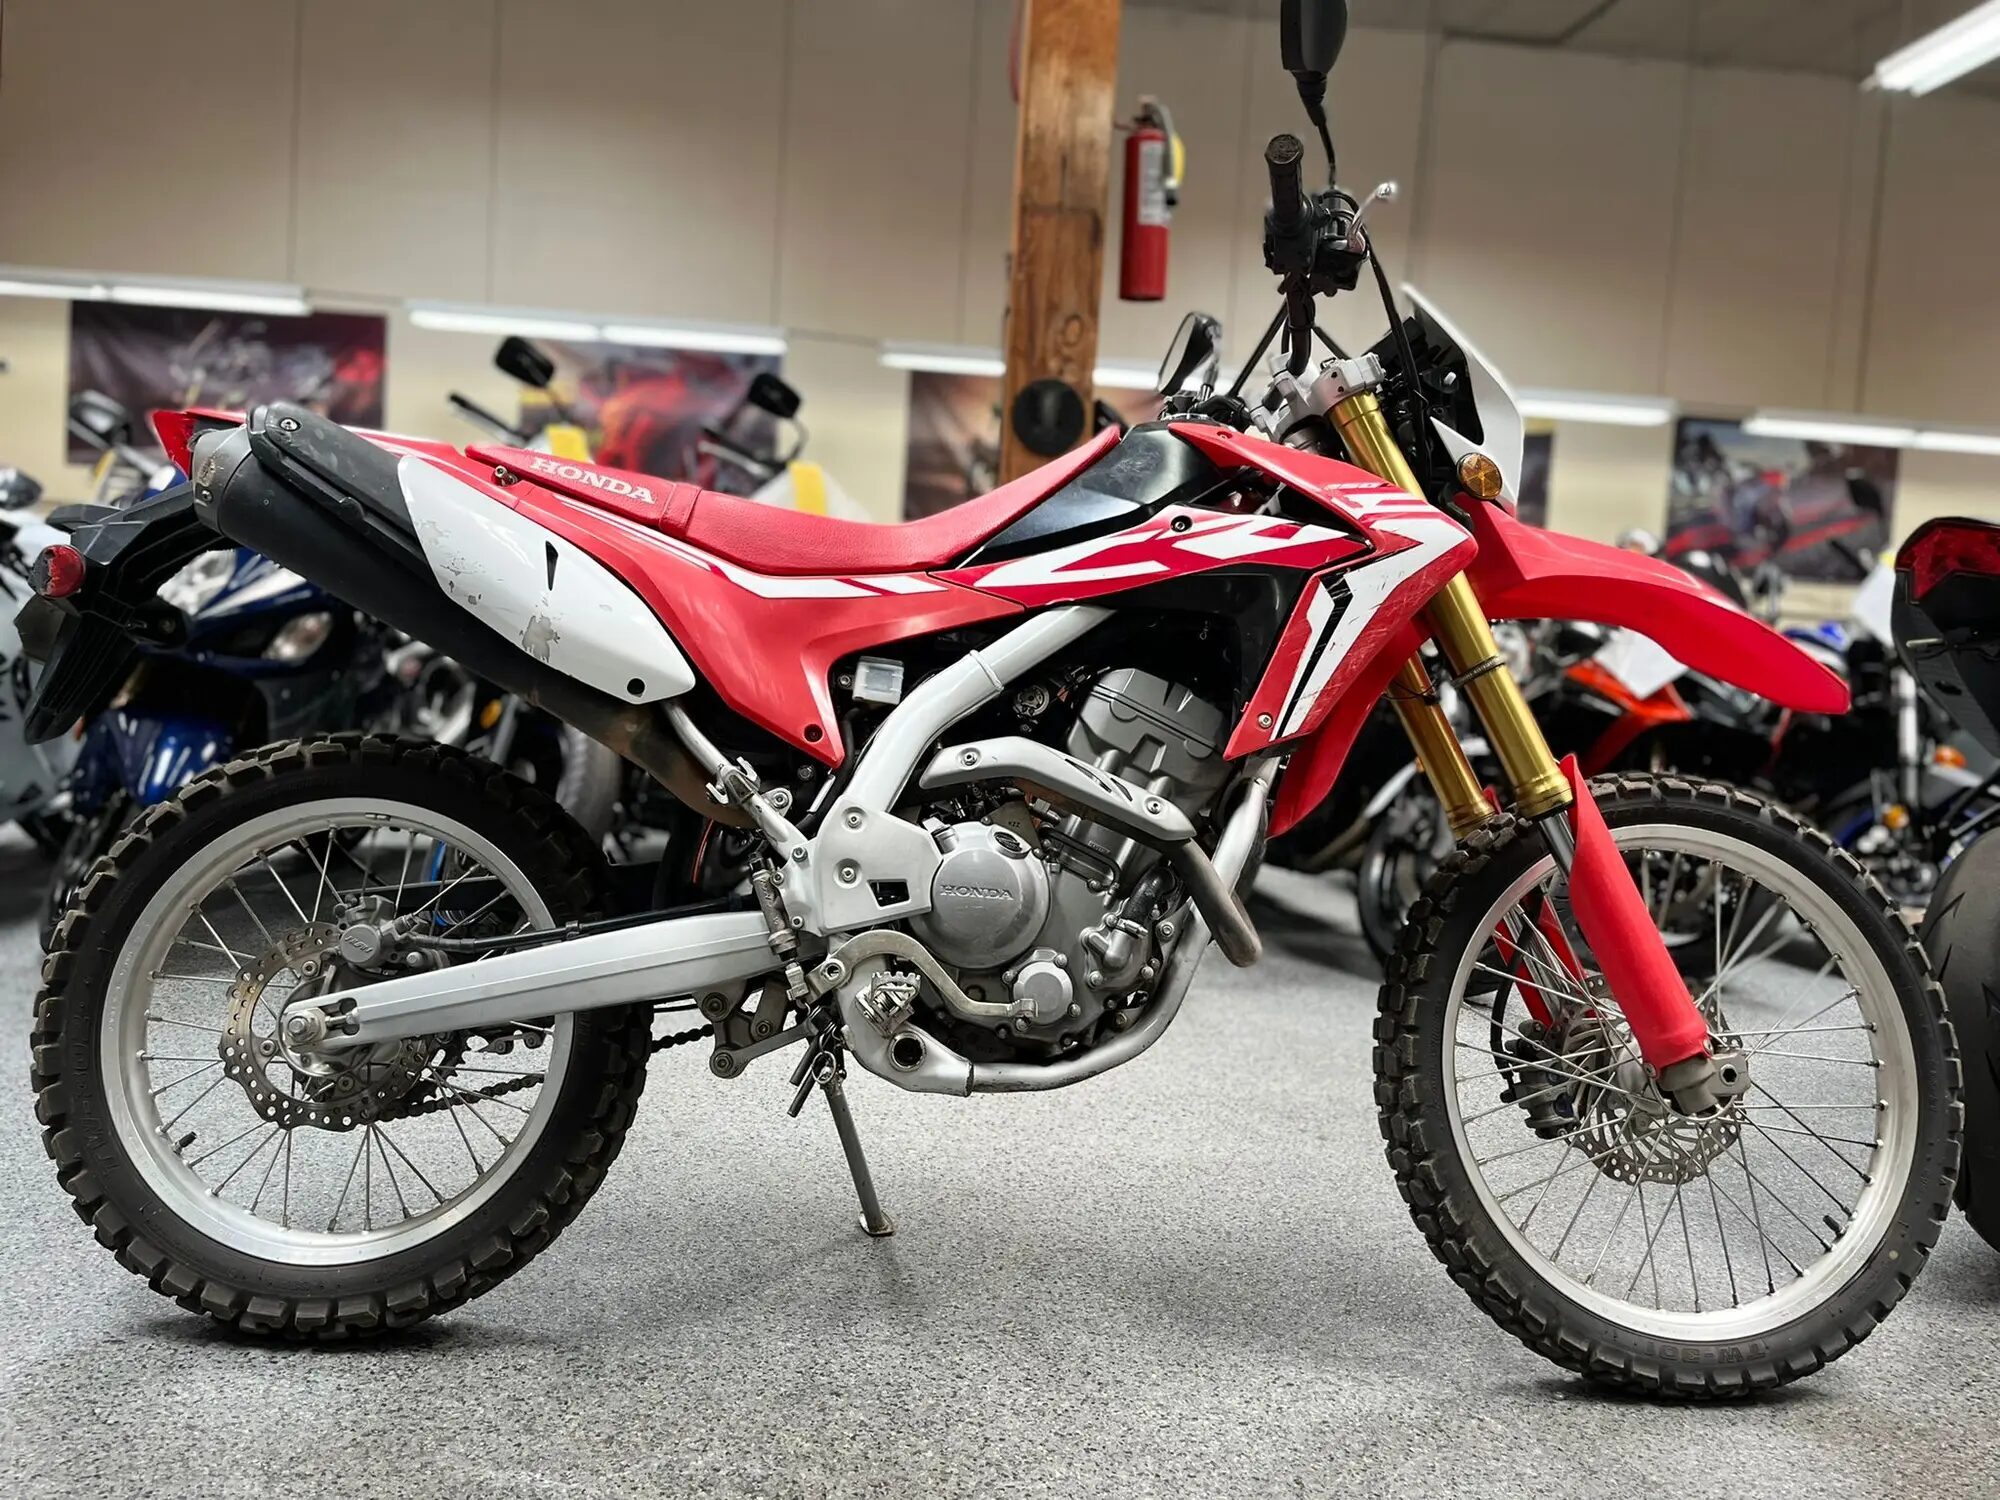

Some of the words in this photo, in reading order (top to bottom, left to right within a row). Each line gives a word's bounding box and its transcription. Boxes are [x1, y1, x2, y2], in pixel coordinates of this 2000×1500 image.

[530, 458, 656, 504] HONDA
[940, 884, 1014, 900] HONDA
[1644, 1342, 1766, 1363] TW-301
